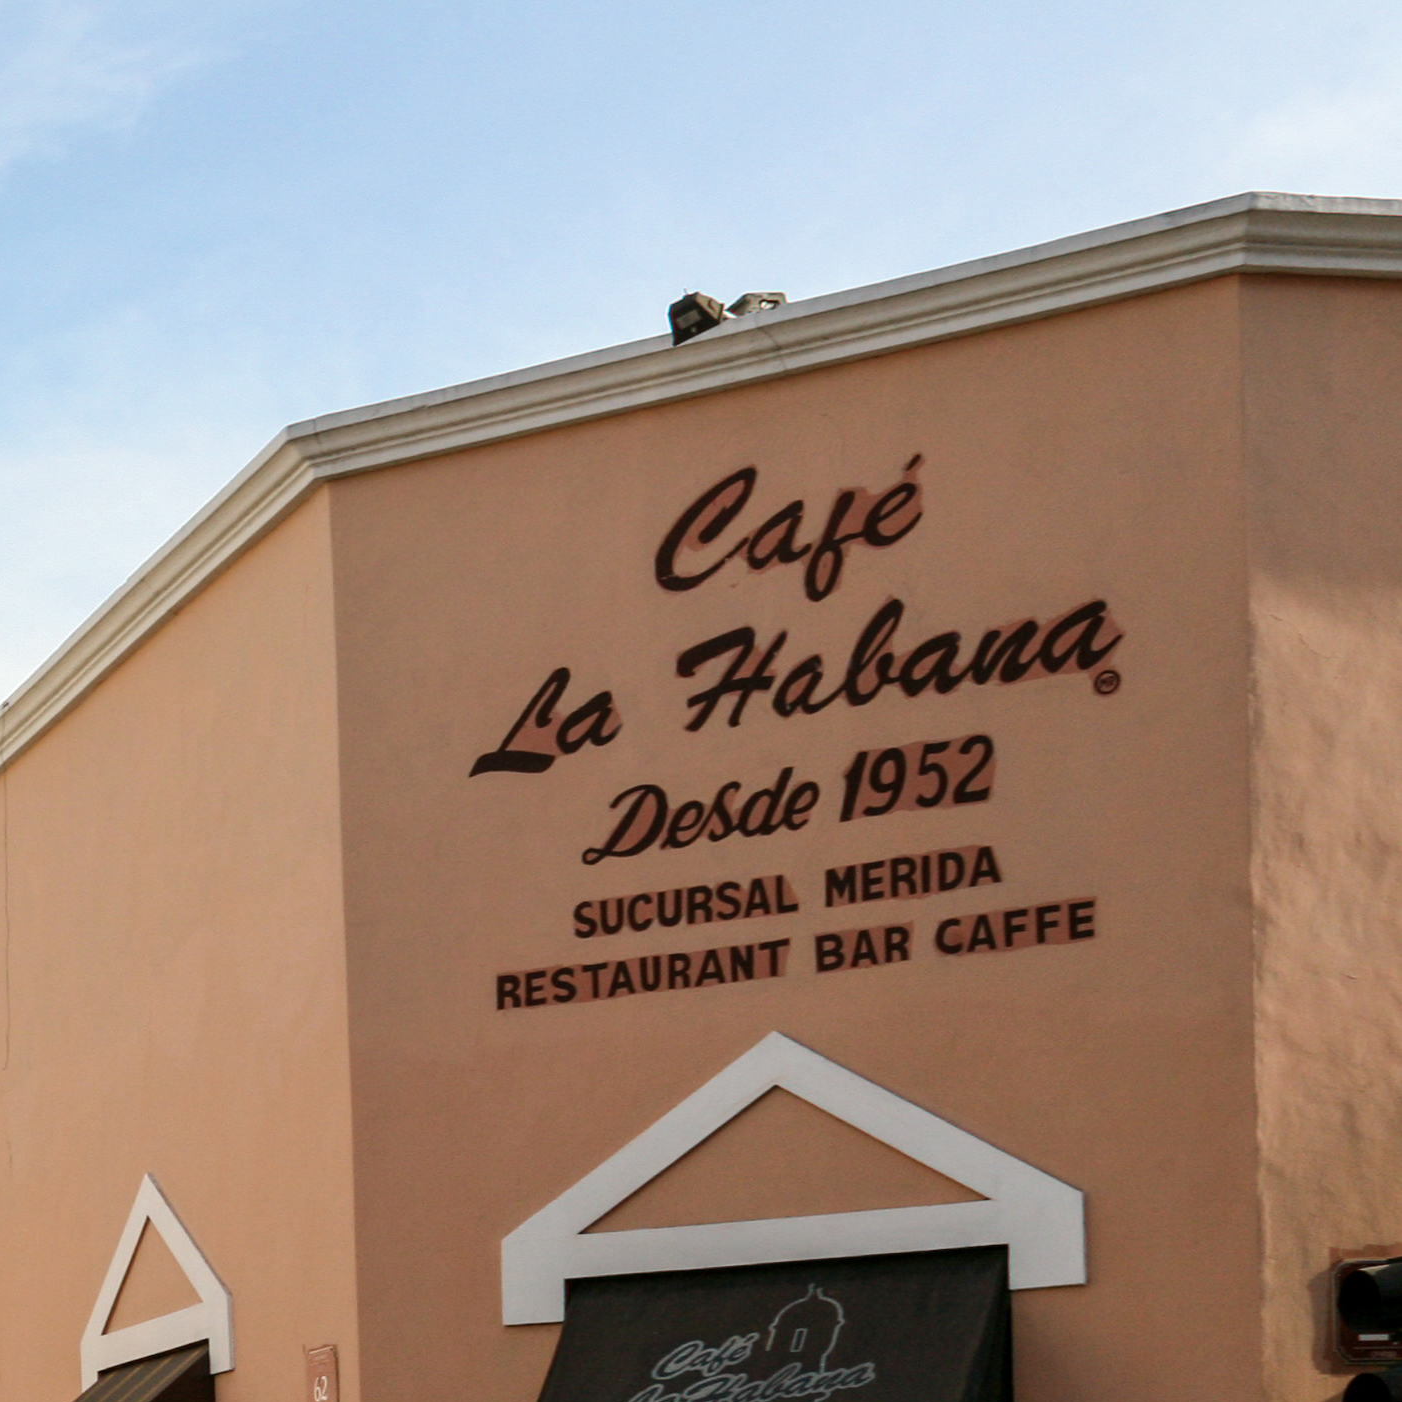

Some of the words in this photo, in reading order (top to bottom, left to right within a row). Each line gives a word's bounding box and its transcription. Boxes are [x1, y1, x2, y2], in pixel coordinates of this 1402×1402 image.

[654, 453, 923, 601] Café
[468, 667, 620, 777] La
[676, 598, 1122, 732] Habana
[581, 766, 820, 865] Desde
[840, 735, 995, 822] 1952
[573, 875, 798, 938] SUCURSAL
[824, 846, 1001, 907] MERIDA
[496, 939, 790, 1009] RESTAURANT
[814, 924, 912, 972] BAR
[933, 900, 1096, 954] CAFFE
[314, 1376, 328, 1402] 62
[651, 1332, 759, 1380] Café
